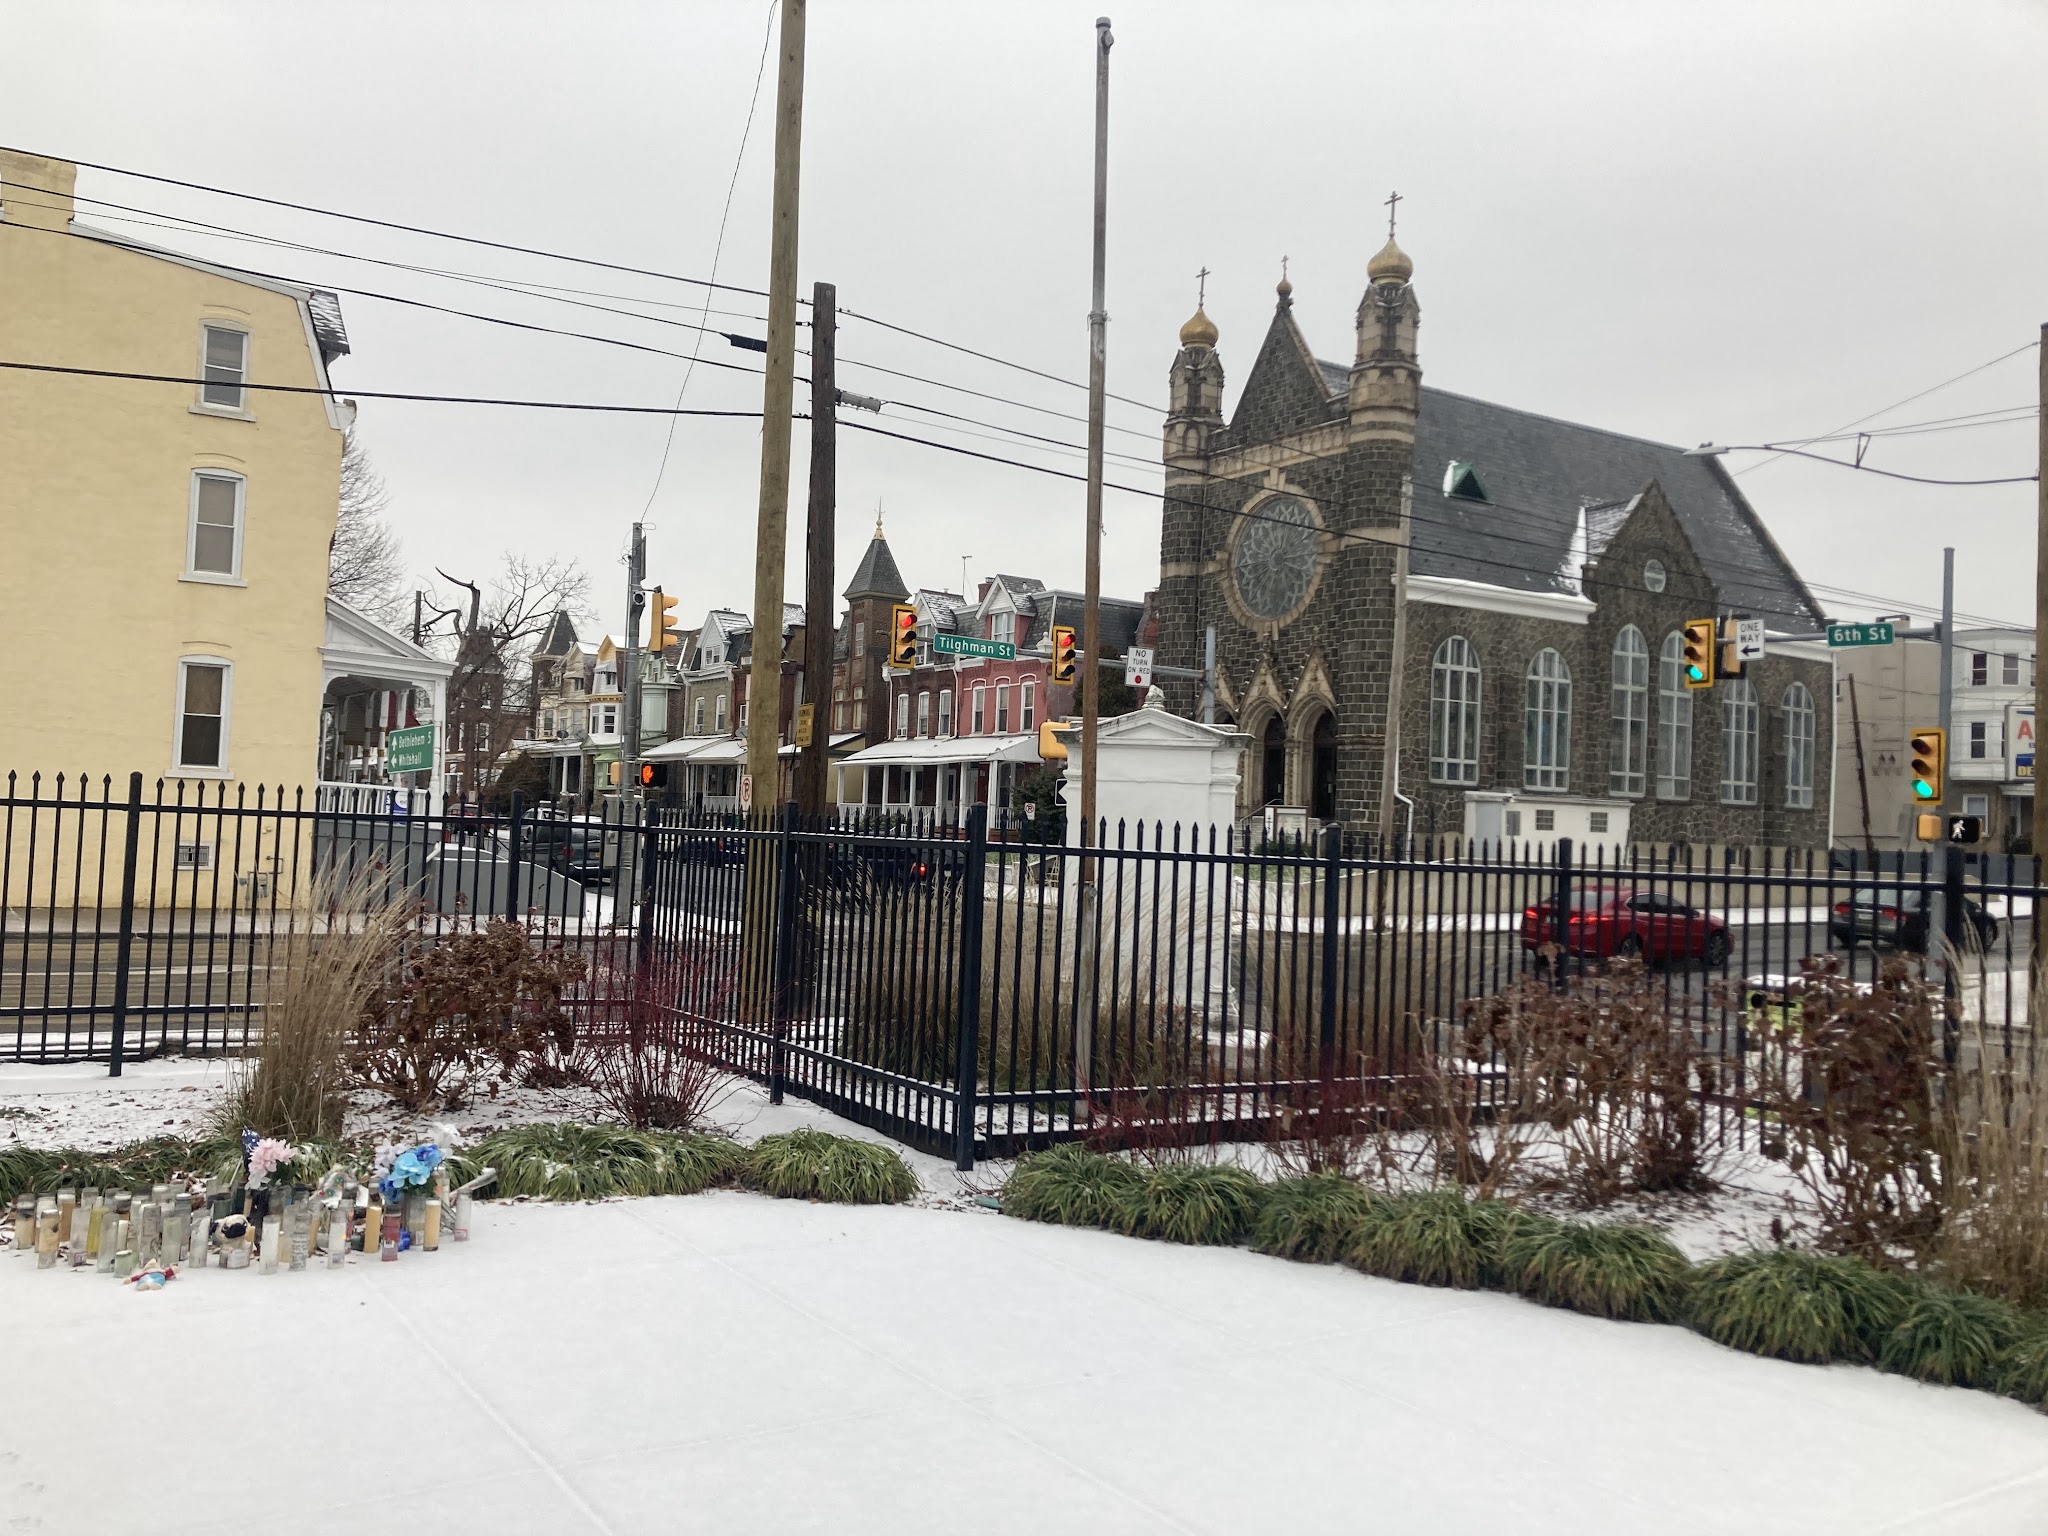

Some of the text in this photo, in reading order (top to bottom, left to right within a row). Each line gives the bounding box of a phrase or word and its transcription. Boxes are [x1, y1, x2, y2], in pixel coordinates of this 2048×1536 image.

[1740, 622, 1759, 633] ONE
[1740, 633, 1760, 643] WAY
[1833, 627, 1887, 642] 6th St
[939, 637, 1011, 657] Tilghman St
[1135, 649, 1147, 658] NO
[1139, 667, 1150, 675] RED
[398, 732, 425, 749] Bethlehem
[398, 751, 422, 767] Whitehall
